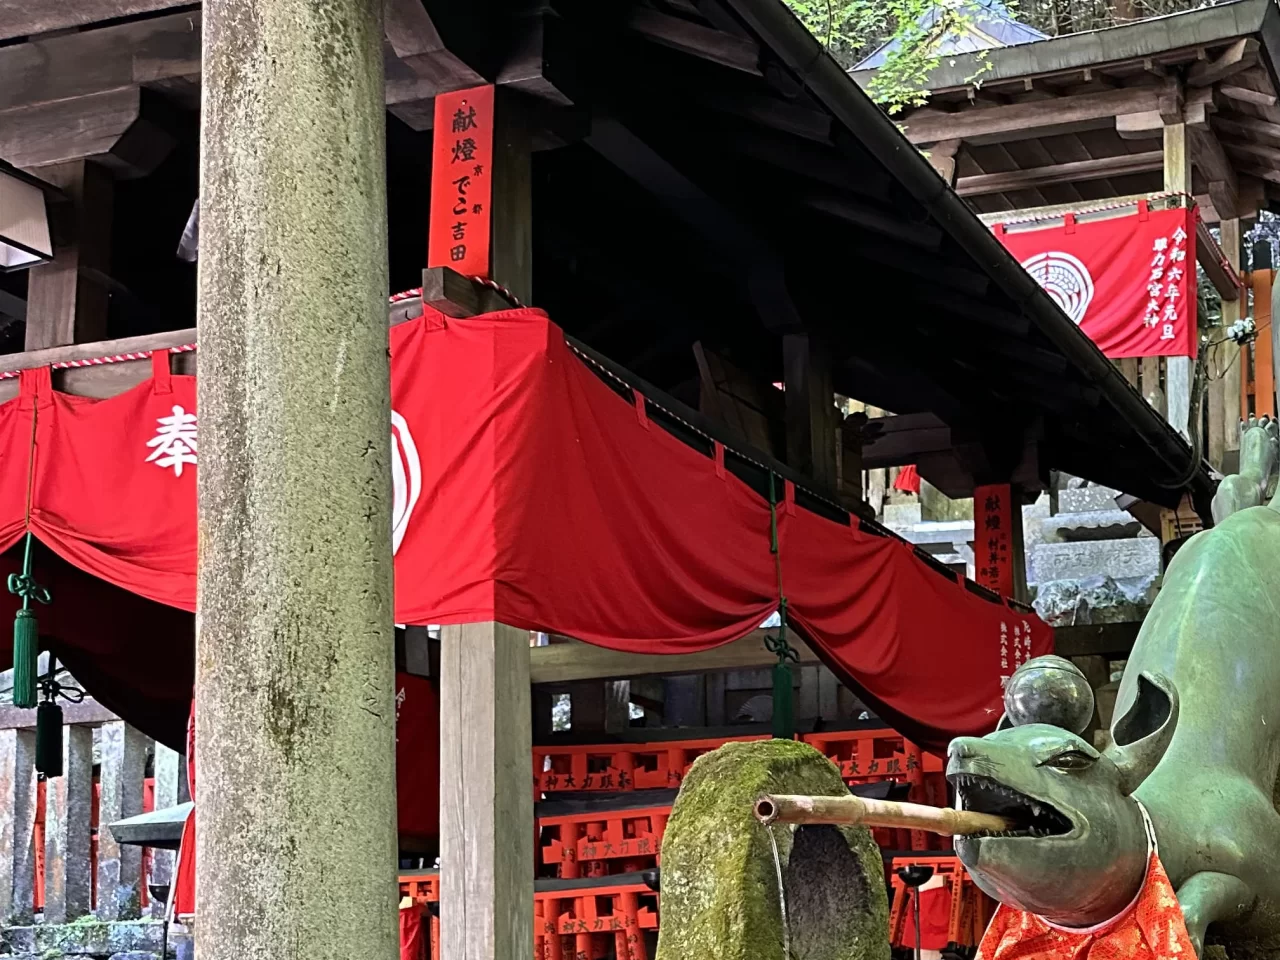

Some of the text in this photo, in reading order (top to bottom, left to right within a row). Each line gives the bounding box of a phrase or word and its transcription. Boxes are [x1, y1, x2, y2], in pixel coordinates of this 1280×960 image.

[1160, 226, 1187, 340] 令和六年元旦
[144, 404, 198, 476] 奉
